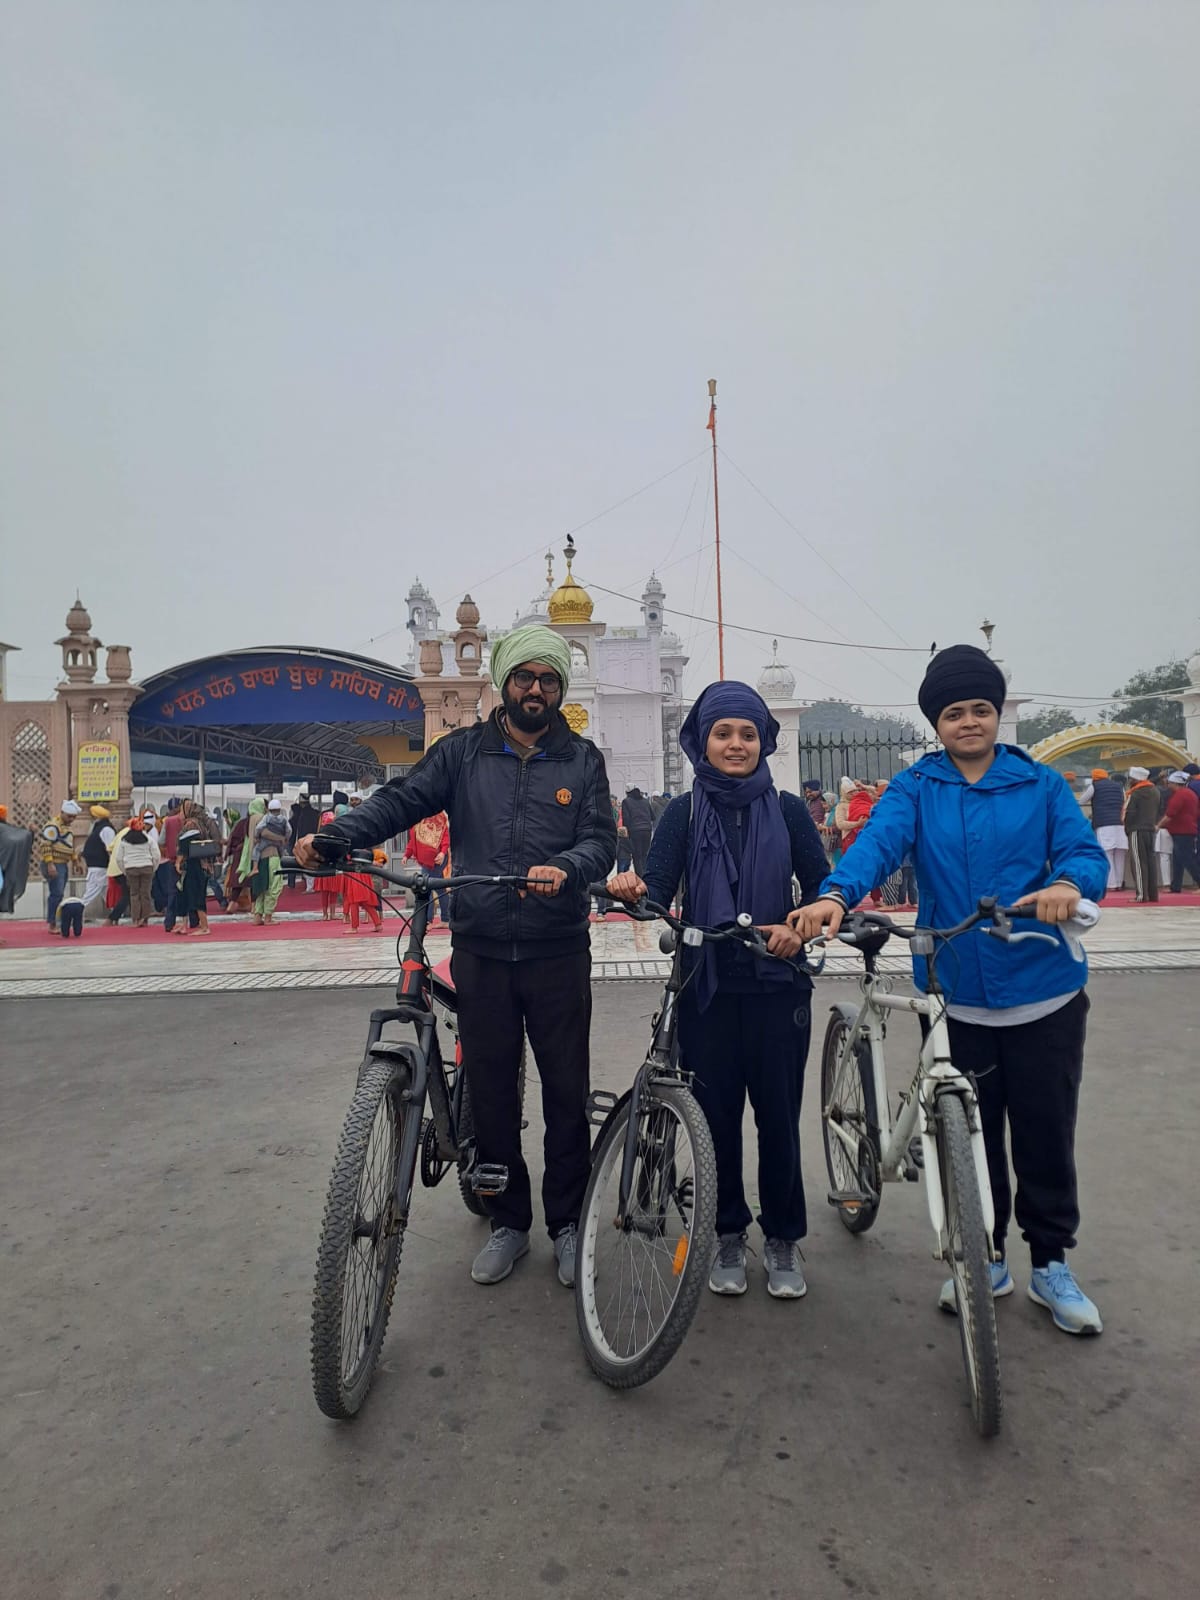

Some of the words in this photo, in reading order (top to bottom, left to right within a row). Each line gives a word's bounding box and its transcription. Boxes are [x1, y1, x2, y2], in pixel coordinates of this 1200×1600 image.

[239, 666, 279, 689] ਬਾਬਾ
[329, 670, 384, 700] ਸਾਹਿਬ
[387, 687, 407, 709] ਜੀ
